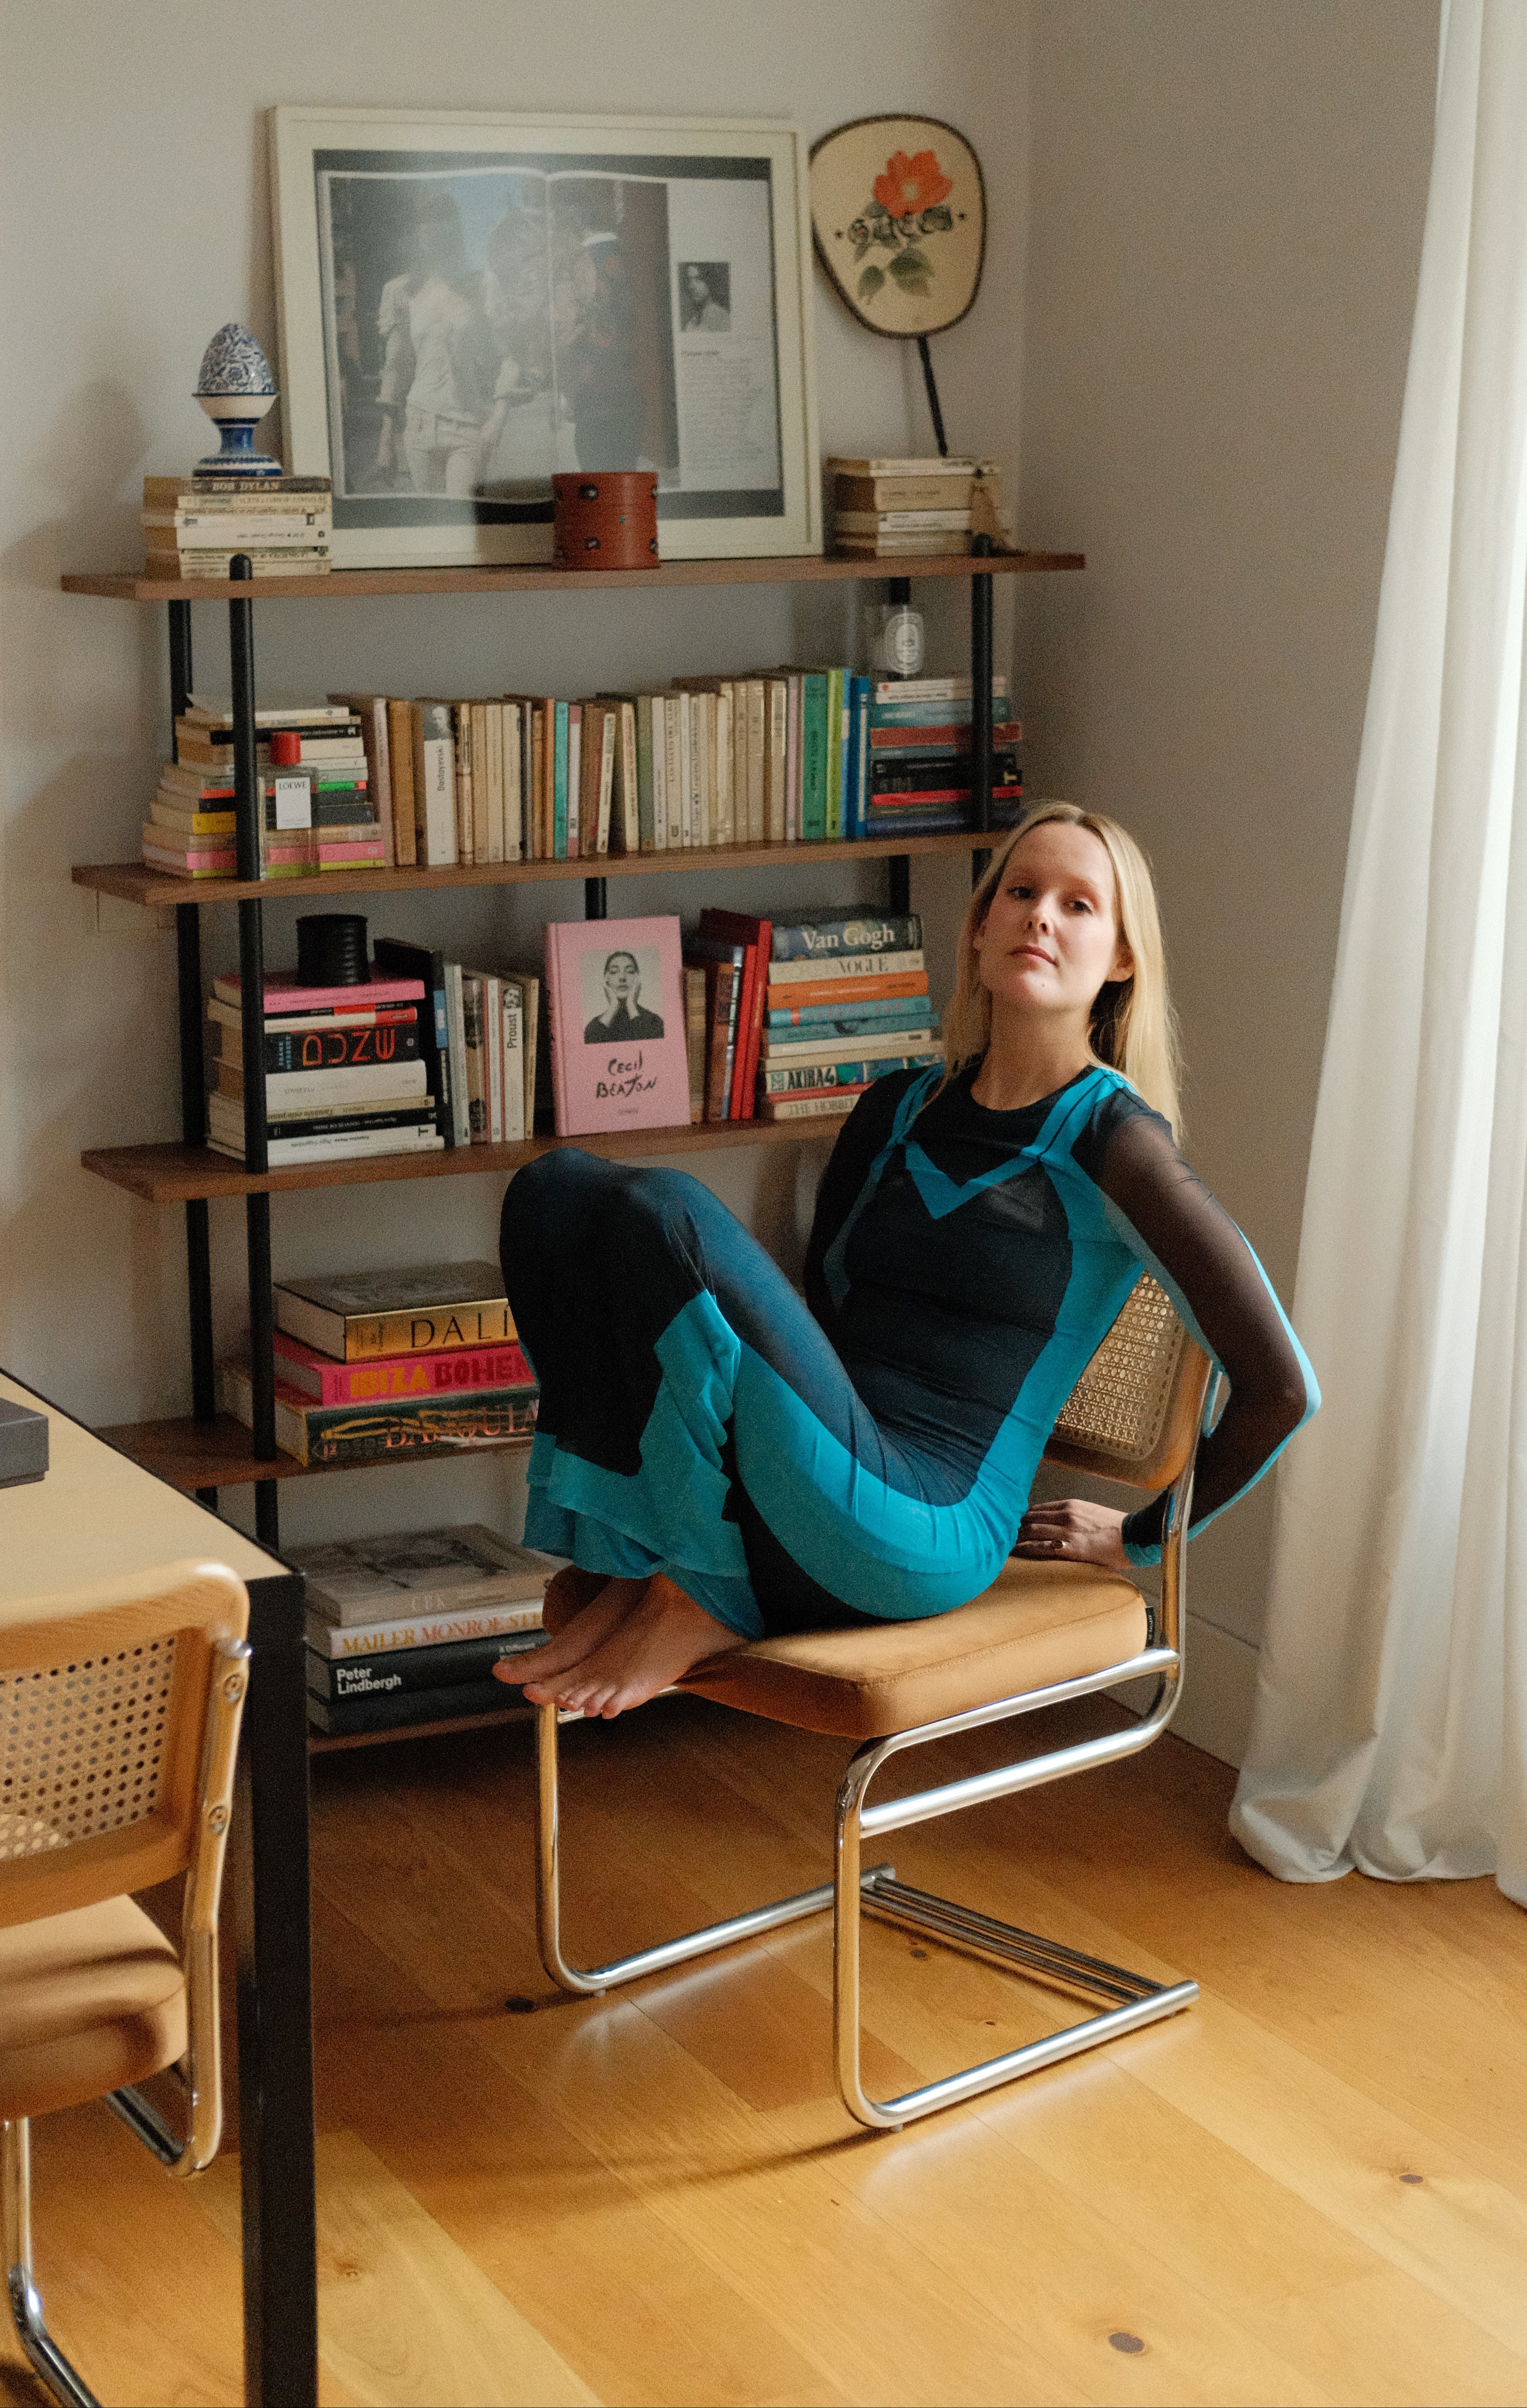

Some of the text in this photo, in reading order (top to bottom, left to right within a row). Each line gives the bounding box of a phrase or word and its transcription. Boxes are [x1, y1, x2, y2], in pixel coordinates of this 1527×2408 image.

[278, 780, 307, 791] LOEWE
[801, 924, 895, 950] Van Gogh
[838, 956, 889, 974] VOGUE
[507, 1012, 517, 1049] Proust
[350, 1365, 430, 1398] IBIZA
[343, 1628, 416, 1653] MAILER
[421, 1616, 503, 1641] MONROE
[337, 1668, 372, 1682] Peter
[337, 1673, 402, 1695] Lindbergh
